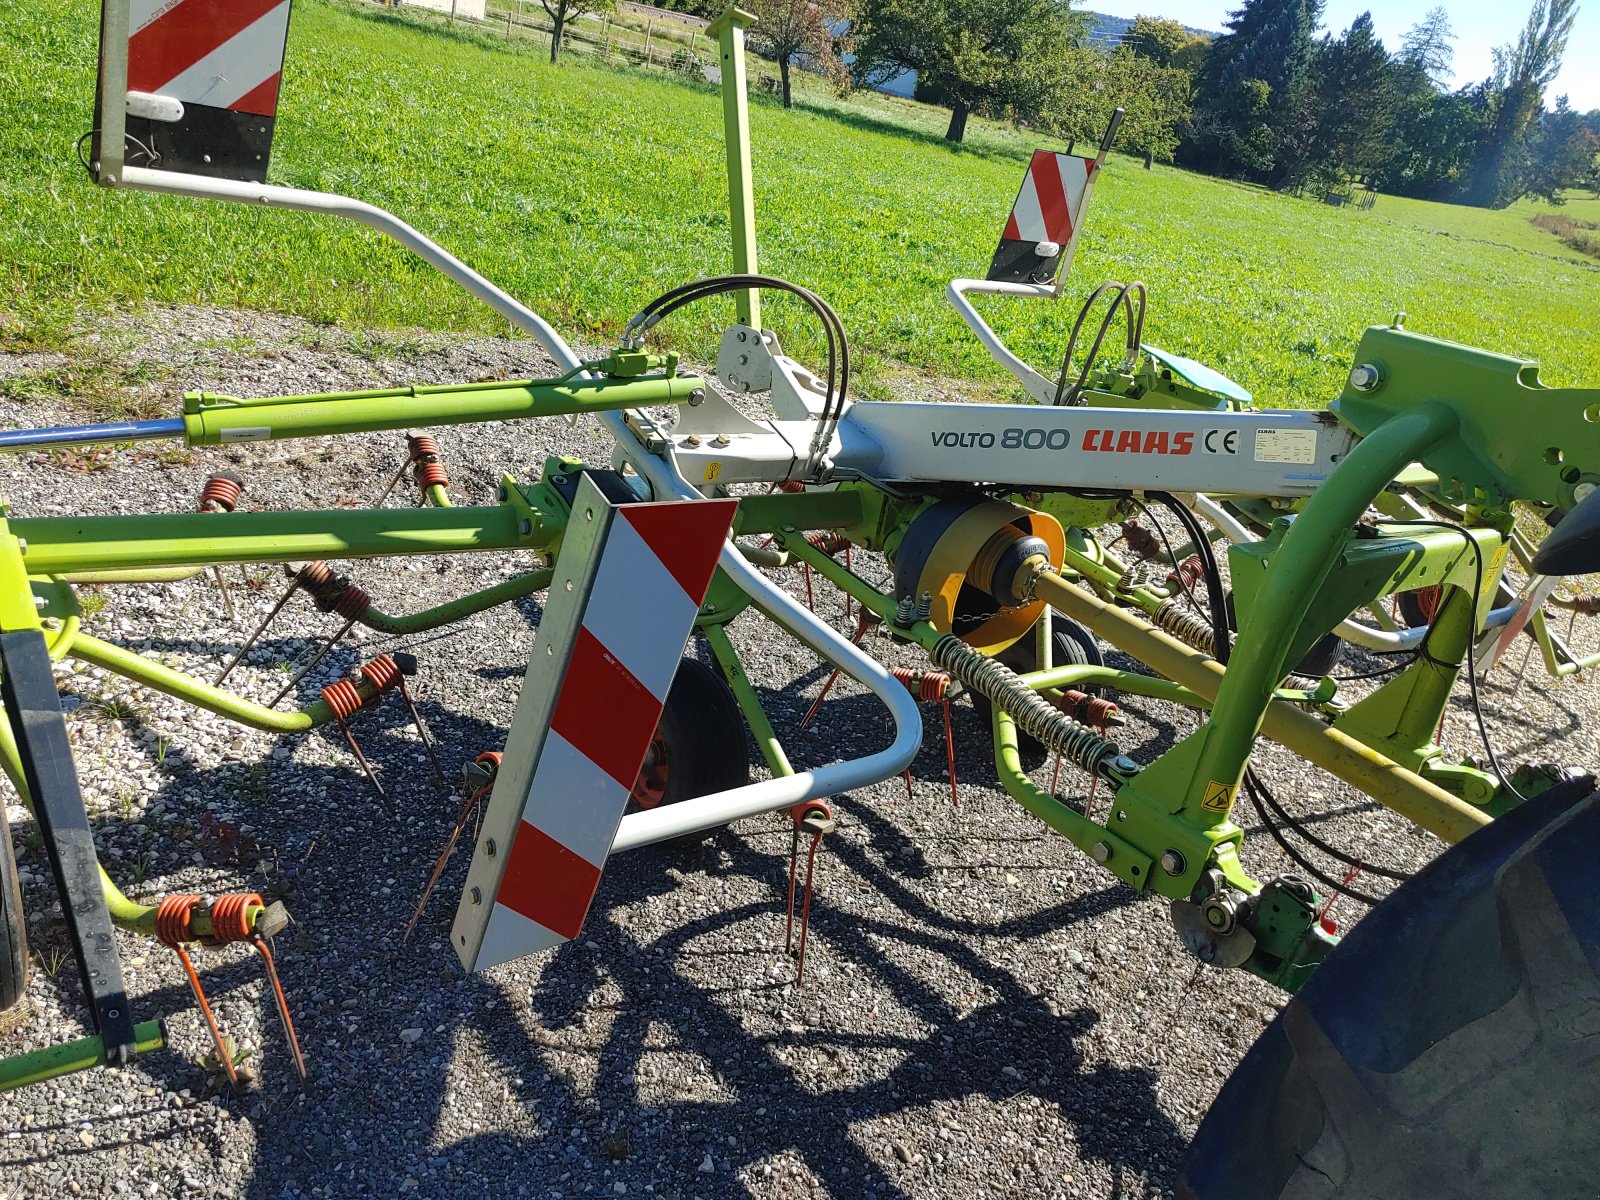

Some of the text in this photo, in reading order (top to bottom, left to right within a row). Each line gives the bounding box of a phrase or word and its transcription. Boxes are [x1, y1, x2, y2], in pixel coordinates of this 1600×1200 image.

[931, 428, 1195, 456] VOLTO 800 CLAAS
